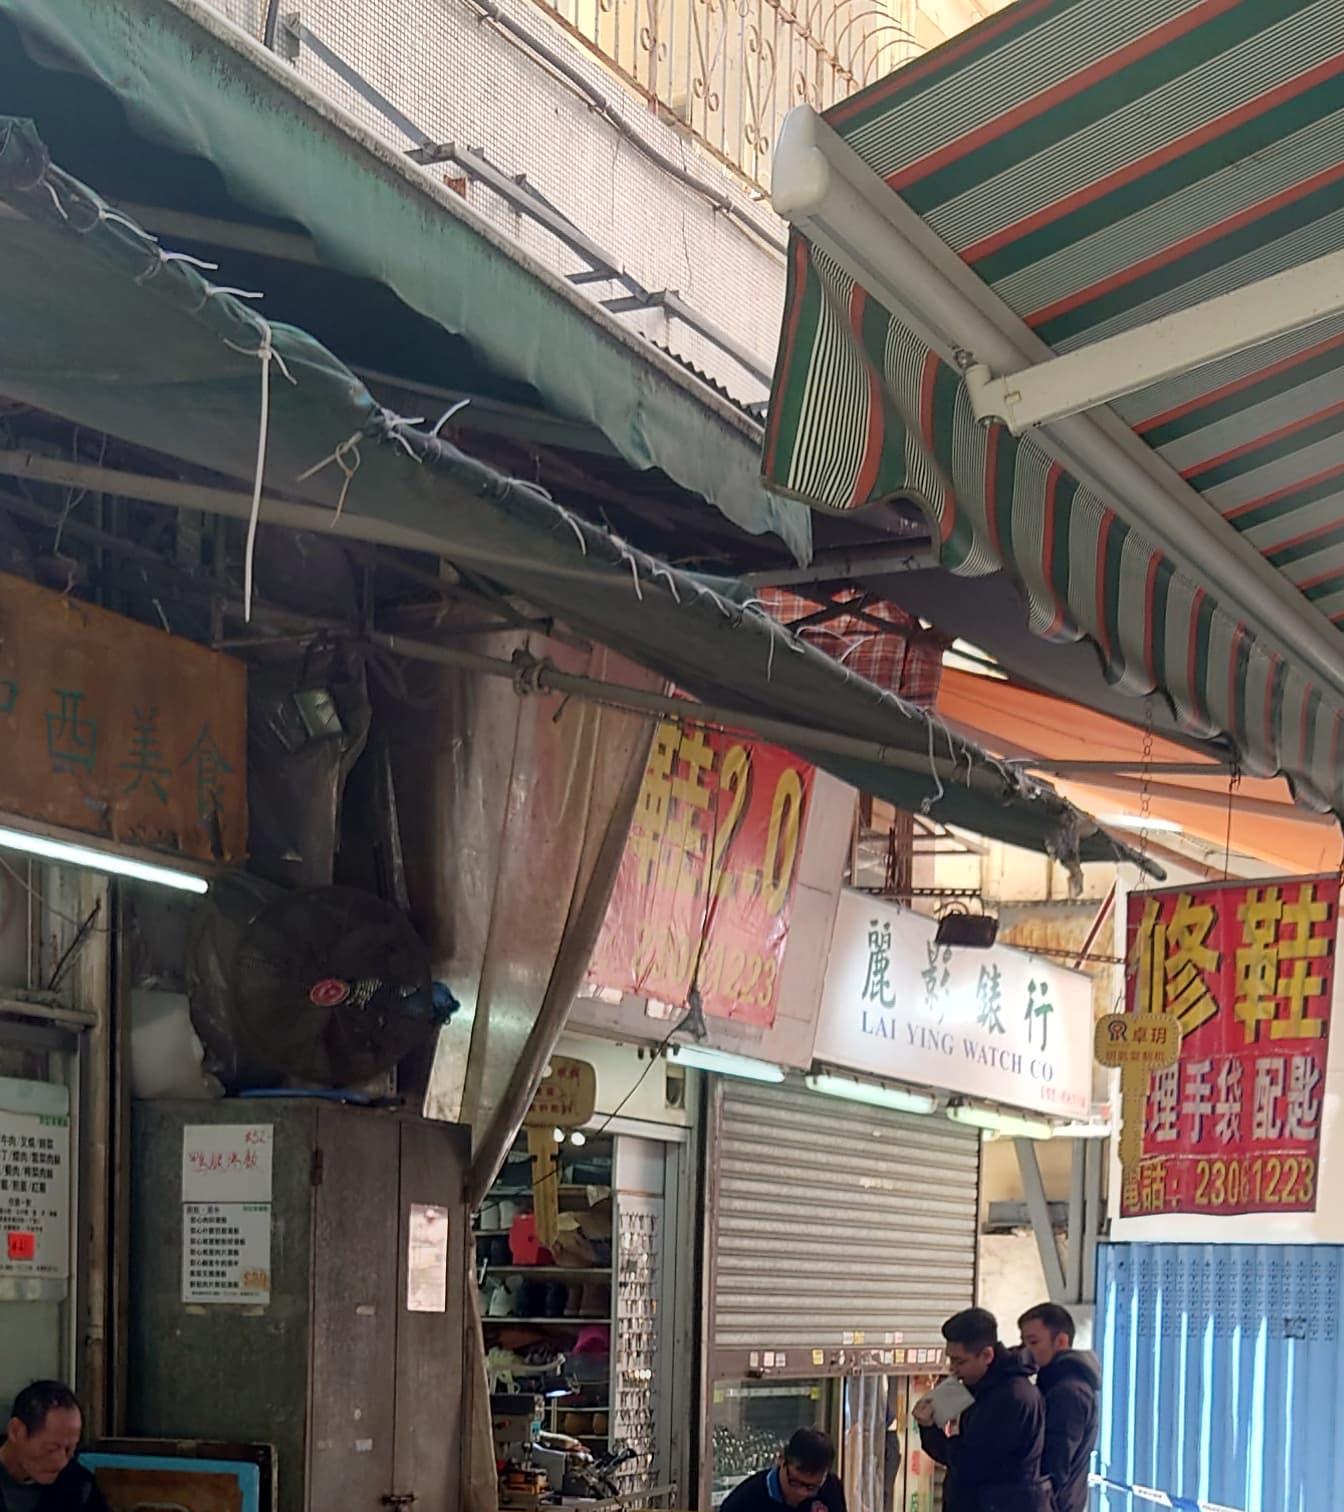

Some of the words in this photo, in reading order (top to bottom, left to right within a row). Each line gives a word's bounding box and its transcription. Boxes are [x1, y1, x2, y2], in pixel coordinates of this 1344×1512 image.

[1130, 882, 1334, 1052] 修鞋
[861, 1010, 897, 1041] LAI
[906, 1023, 954, 1056] YING
[963, 1037, 1022, 1075] WATCH
[1030, 1058, 1054, 1082] CO
[1252, 1057, 1320, 1141] 配匙
[1193, 1156, 1316, 1207] 23061223
